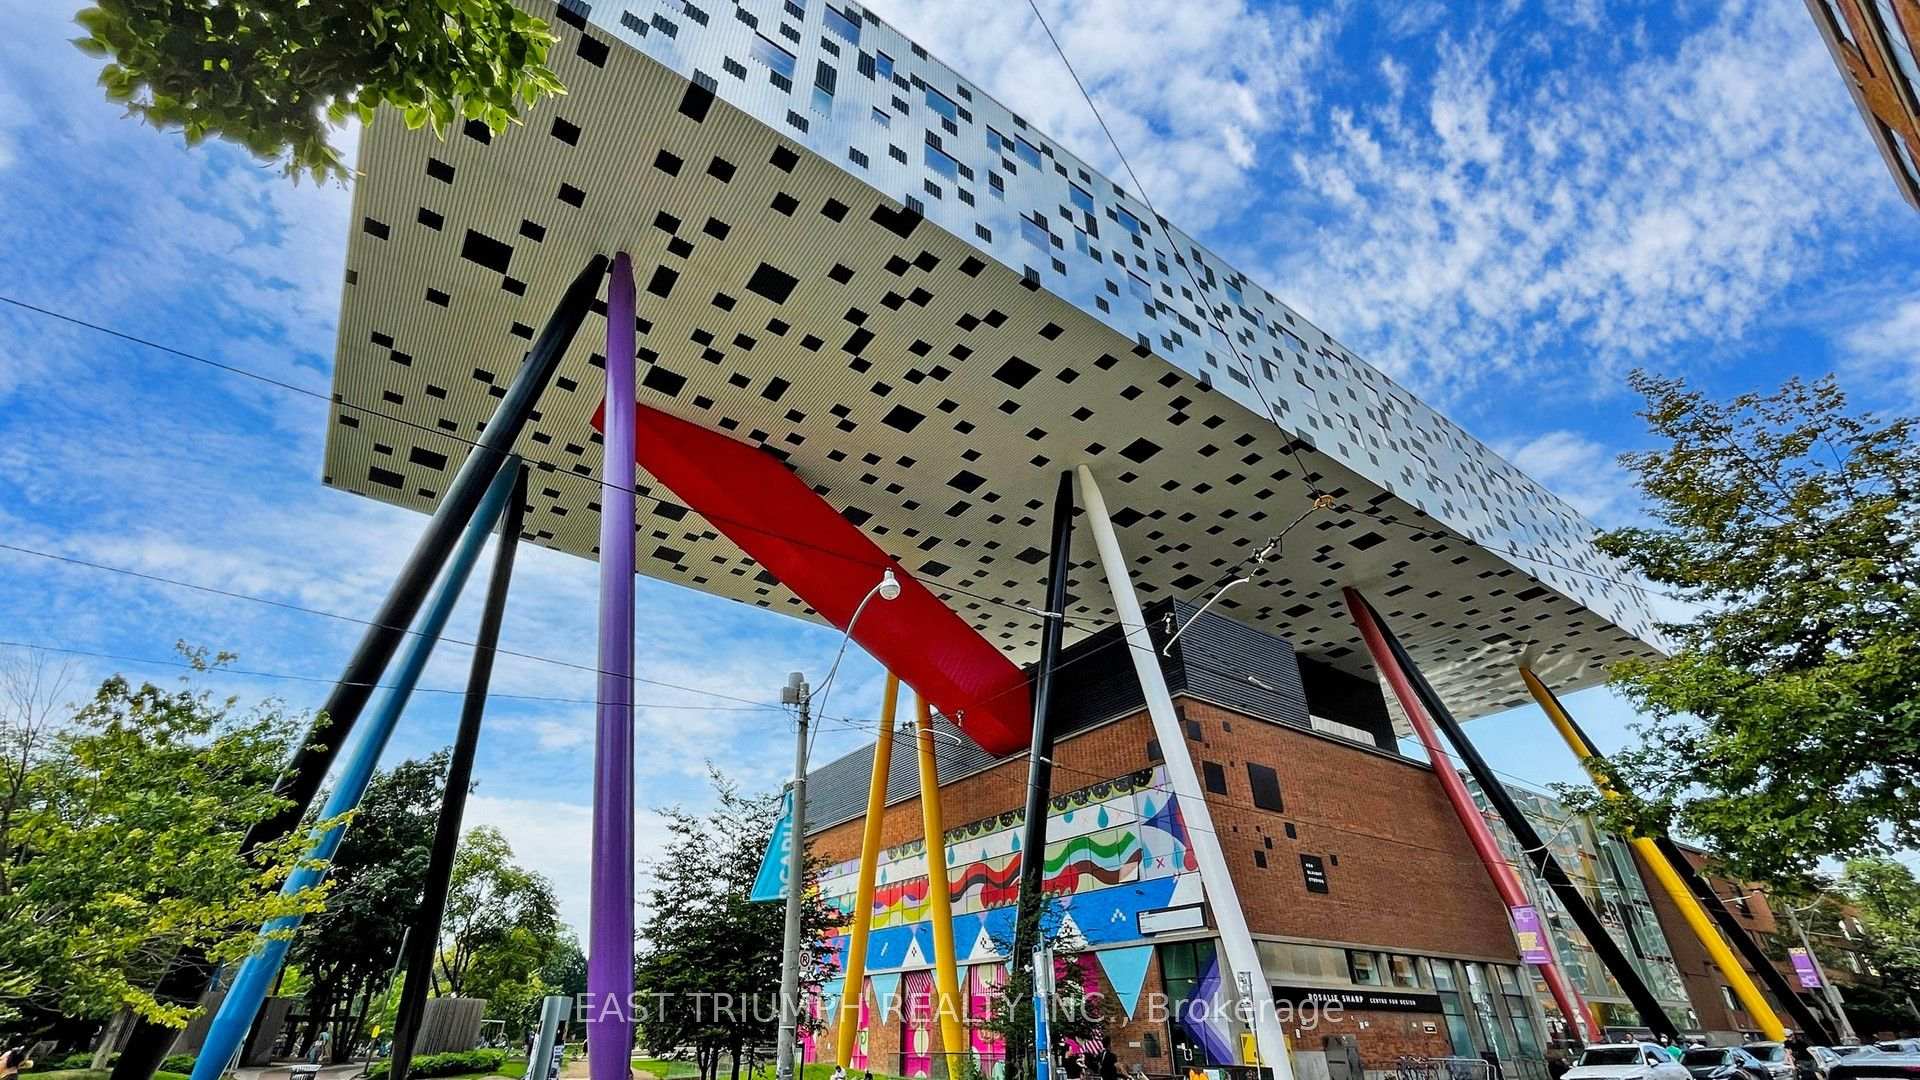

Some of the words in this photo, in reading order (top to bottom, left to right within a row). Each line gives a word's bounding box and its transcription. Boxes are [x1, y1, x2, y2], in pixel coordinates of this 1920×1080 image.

[1307, 993, 1338, 1002] ROSALIE
[1341, 994, 1364, 1003] SHARP
[1369, 997, 1388, 1005] CENTRE
